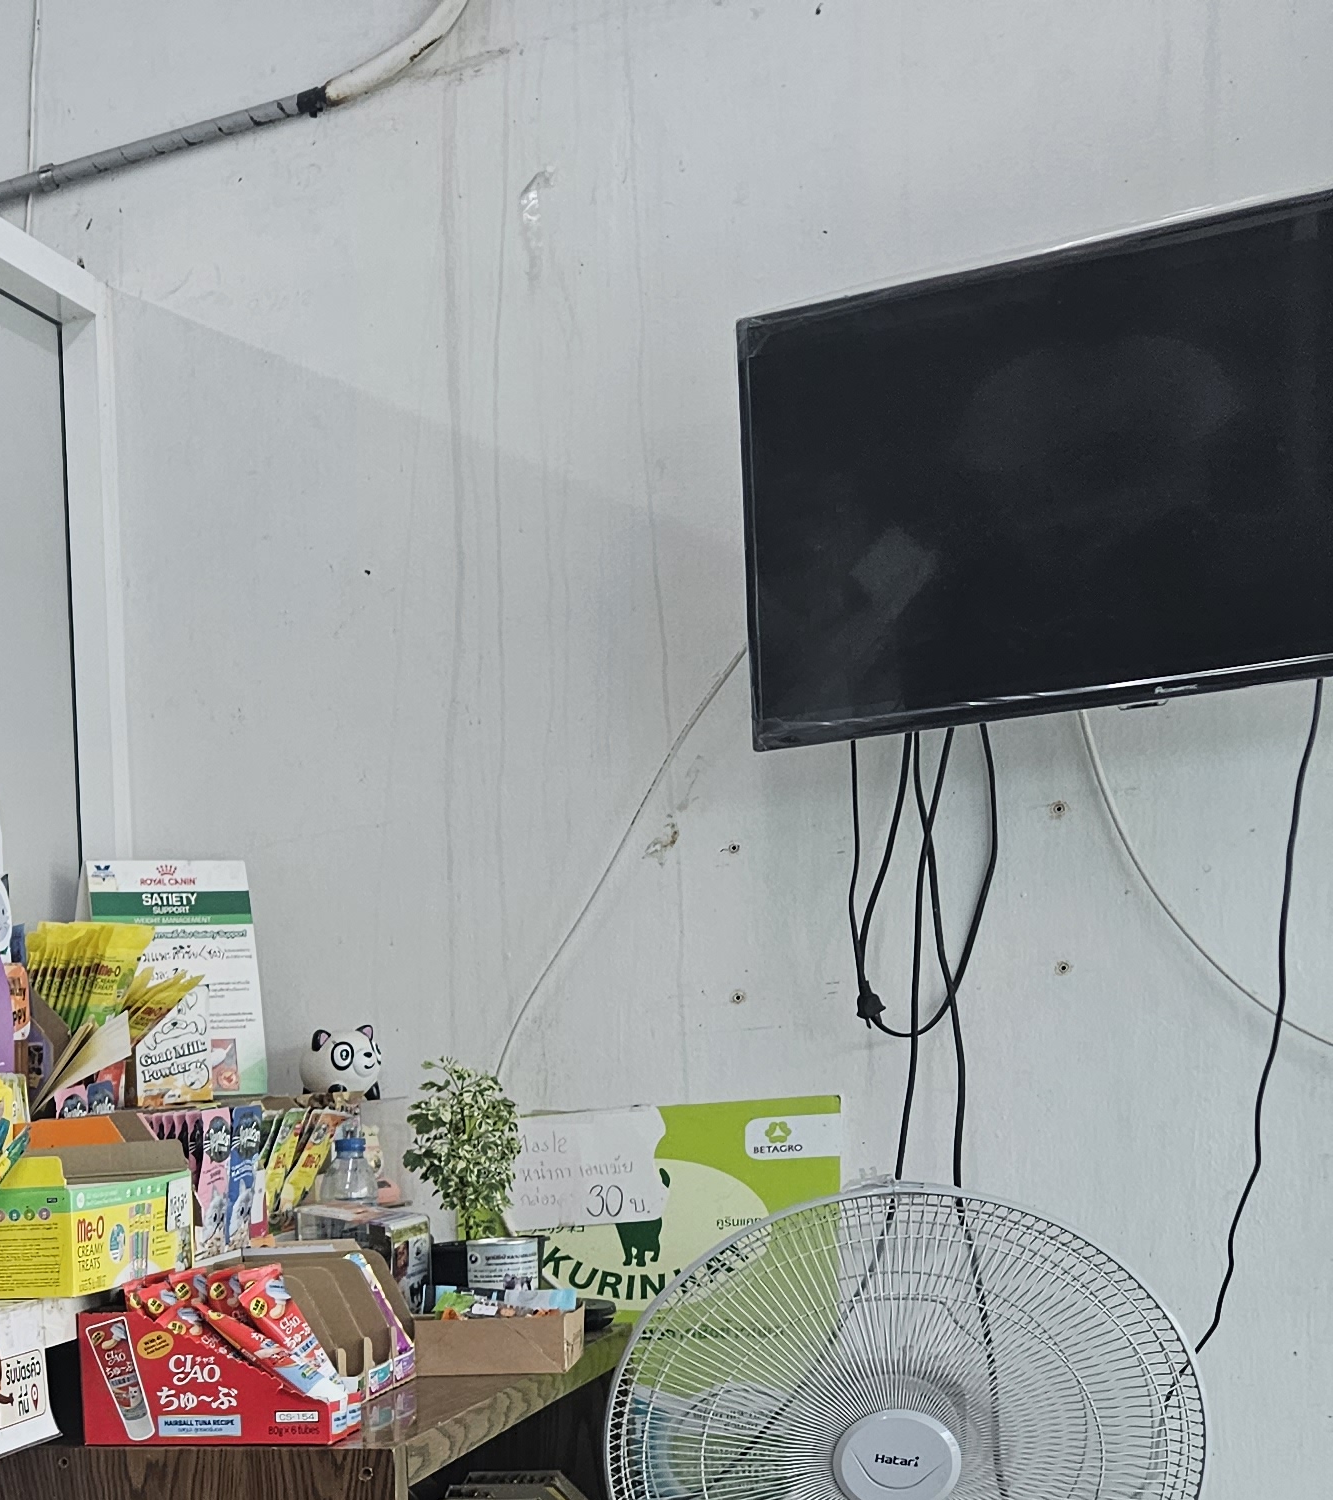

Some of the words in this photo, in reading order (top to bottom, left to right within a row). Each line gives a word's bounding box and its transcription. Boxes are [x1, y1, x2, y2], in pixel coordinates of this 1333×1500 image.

[140, 878, 166, 886] ROYAL
[168, 877, 196, 886] CANIN
[142, 893, 197, 906] SATIETY
[153, 906, 190, 914] SUPPORT
[140, 1051, 172, 1068] Goat
[141, 1061, 191, 1083] Powder
[753, 1143, 803, 1154] BETAGRO
[586, 1184, 624, 1217] 30
[77, 1214, 105, 1244] Me-O
[77, 1242, 104, 1259] CREAMY
[77, 1257, 101, 1273] TREATS
[5, 1356, 41, 1386] รับบัตรคิว
[169, 1354, 221, 1386] CIAO
[163, 1420, 193, 1428] HAIRBALL
[212, 1419, 235, 1427] RECIPE
[277, 1412, 317, 1422] CS-154
[296, 1424, 321, 1436] tubes
[874, 1452, 921, 1469] Hatari
